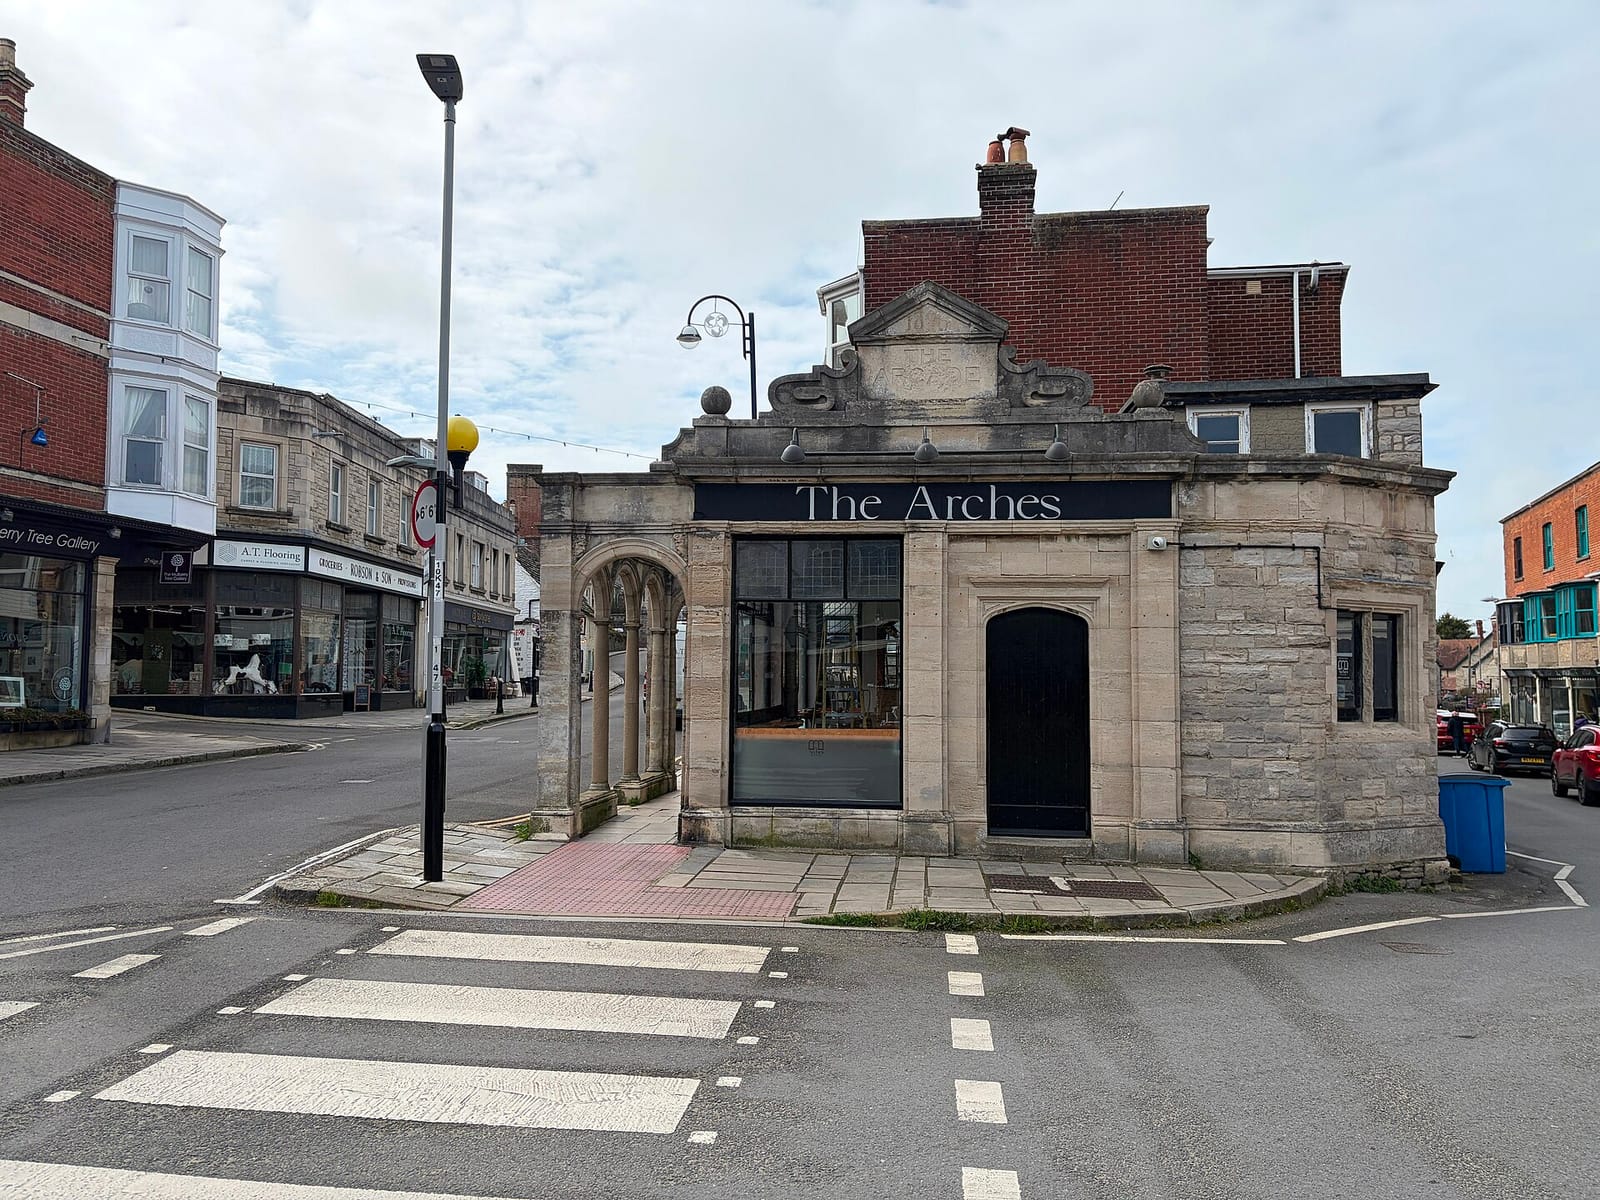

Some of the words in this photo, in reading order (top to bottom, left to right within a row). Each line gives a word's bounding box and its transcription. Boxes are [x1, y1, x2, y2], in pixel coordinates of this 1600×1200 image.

[903, 348, 952, 365] THE
[794, 485, 882, 521] The
[905, 485, 1063, 521] Arches
[0, 528, 25, 544] erry
[27, 529, 54, 545] Tree
[56, 533, 101, 554] Gallery
[241, 546, 260, 557] A.T.
[263, 548, 302, 563] Flooring
[350, 562, 373, 581] ROBSON
[375, 571, 379, 583] &
[381, 571, 392, 585] SON
